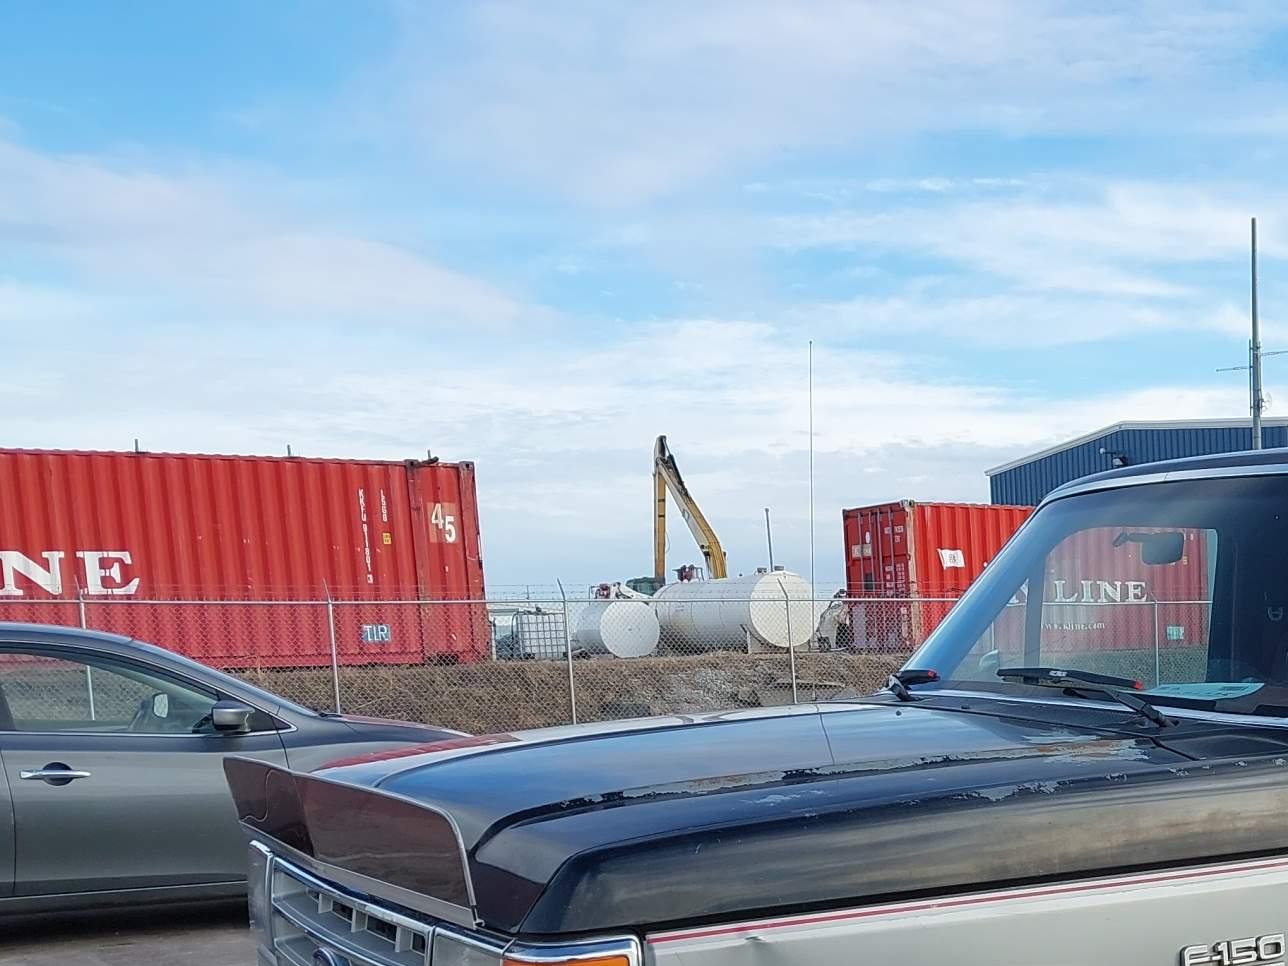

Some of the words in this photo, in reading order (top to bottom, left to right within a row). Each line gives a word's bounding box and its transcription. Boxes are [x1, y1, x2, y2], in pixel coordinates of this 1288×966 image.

[431, 503, 456, 543] 45
[1053, 580, 1148, 603] LINE
[363, 624, 390, 642] TIR
